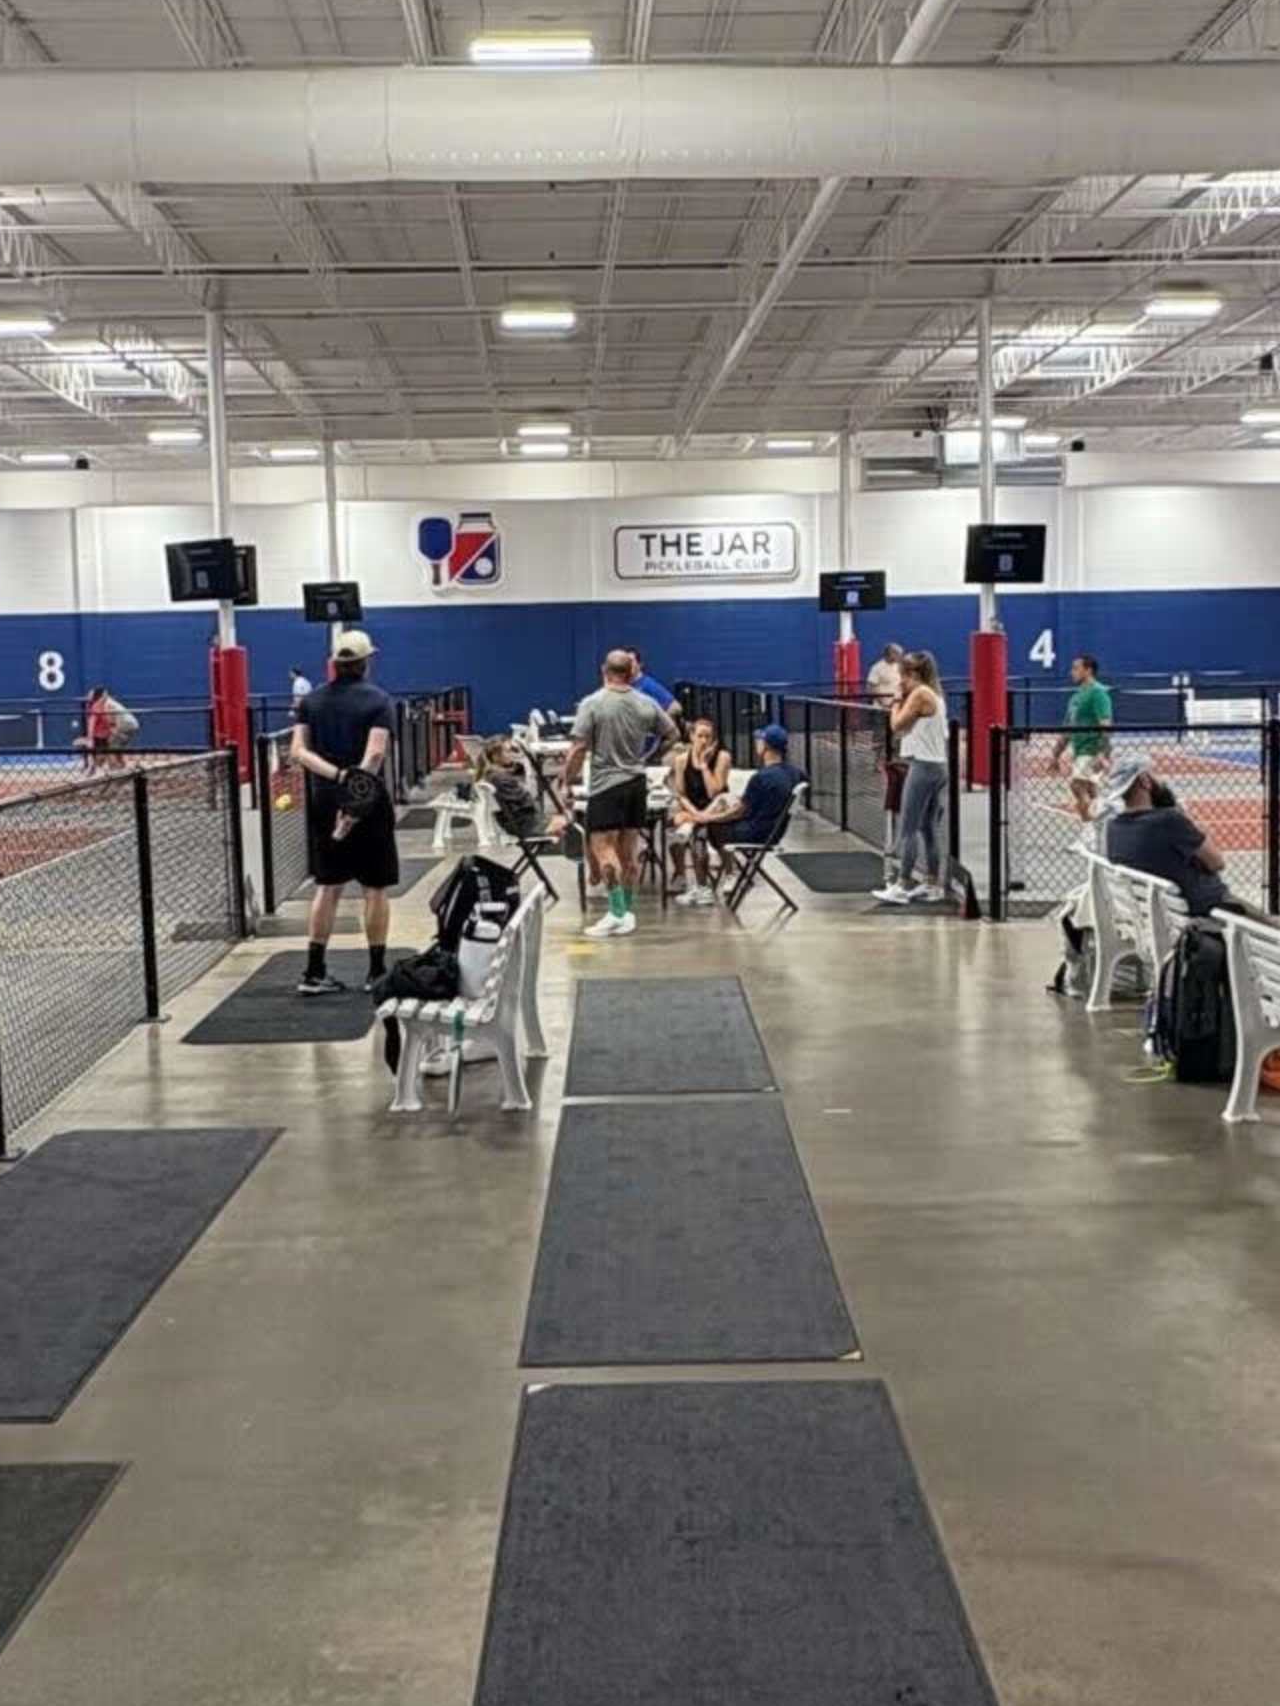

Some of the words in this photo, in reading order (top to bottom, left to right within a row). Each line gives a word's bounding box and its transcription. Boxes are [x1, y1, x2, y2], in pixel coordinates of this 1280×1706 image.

[638, 532, 704, 557] THE
[711, 530, 771, 555] JAR
[644, 559, 730, 573] PICKLEBALL
[735, 557, 771, 571] CLUB
[1029, 629, 1056, 668] 4
[39, 651, 64, 691] 8
